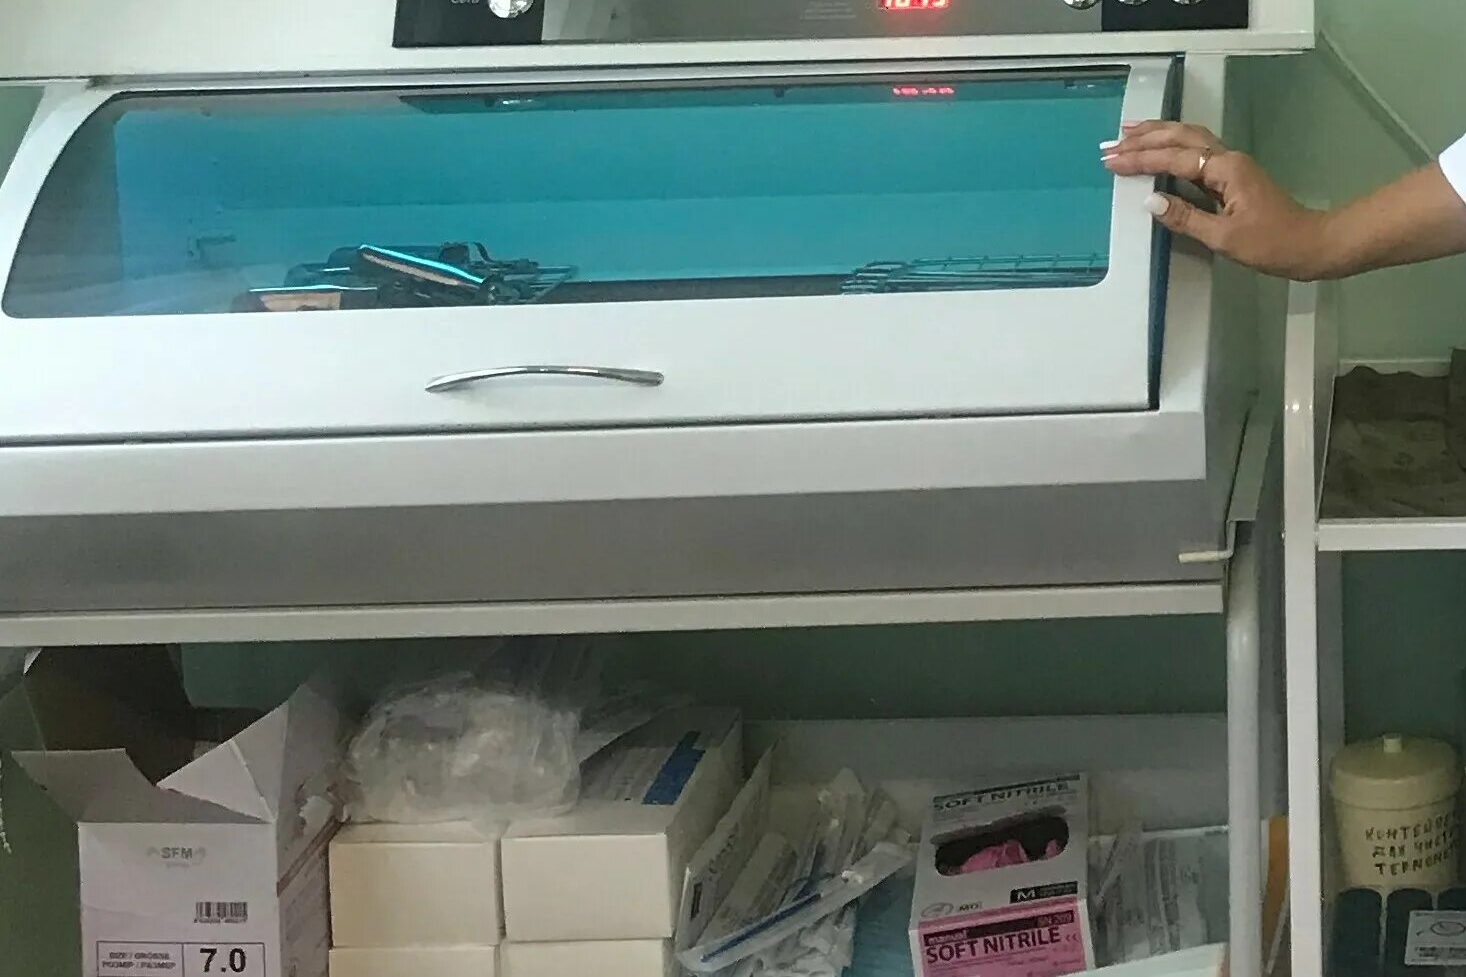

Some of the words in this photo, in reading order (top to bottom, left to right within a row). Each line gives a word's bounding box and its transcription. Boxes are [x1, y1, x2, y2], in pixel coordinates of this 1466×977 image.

[933, 793, 987, 811] SOFT
[990, 781, 1069, 802] NITRILE
[161, 847, 193, 859] SFM
[1016, 889, 1036, 901] M
[925, 940, 979, 964] SOFT
[982, 925, 1062, 955] NITRILE
[199, 948, 247, 973] 7.0
